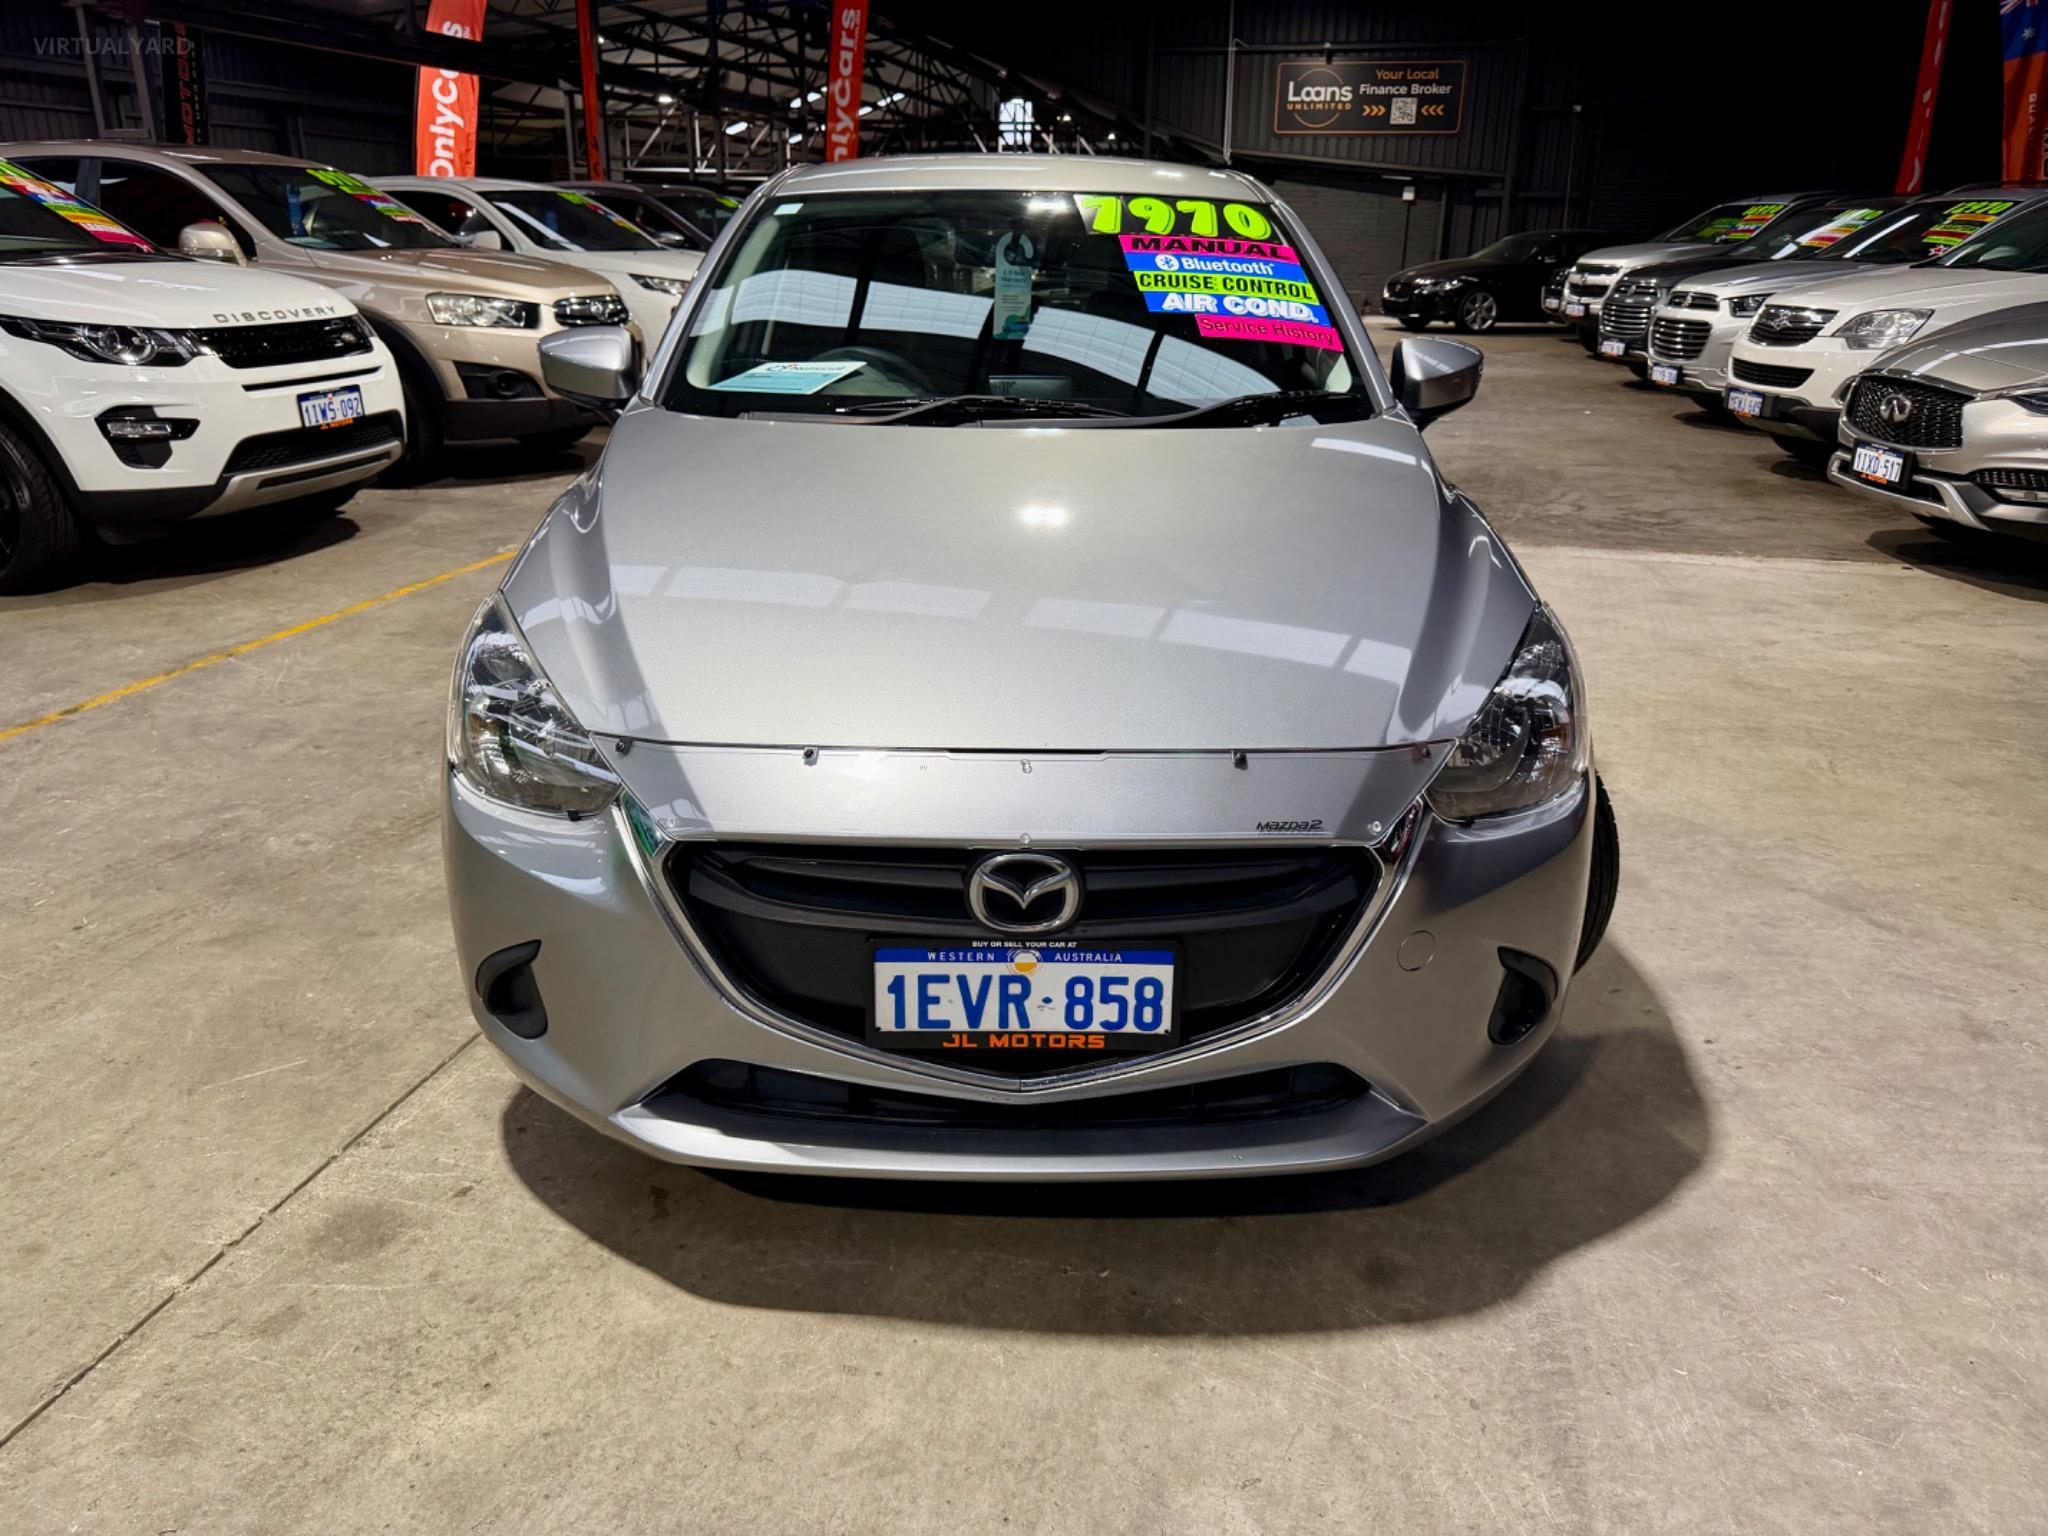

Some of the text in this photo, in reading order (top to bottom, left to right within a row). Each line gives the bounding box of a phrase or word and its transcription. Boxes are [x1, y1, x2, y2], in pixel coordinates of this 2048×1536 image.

[831, 8, 855, 162] nlyCars
[1375, 69, 1439, 80] Your Local
[429, 21, 465, 177] OnlyCs
[1287, 80, 1353, 102] Loans
[1359, 83, 1452, 95] Finance Broker
[1082, 196, 1272, 241] 7970
[1131, 236, 1291, 262] MANUAL
[1182, 257, 1274, 276] Bluetooth
[1139, 272, 1313, 300] CRUISE CONTROL
[213, 305, 336, 324] DISCOVERY
[1161, 292, 1318, 324] AIR COND.
[1200, 317, 1333, 347] Service History
[972, 940, 1078, 948] BUY OR SELL YOUR CAR AT
[927, 951, 1123, 963] WESTERN AUSTRALIA
[942, 1033, 1105, 1049] JL MOTORS
